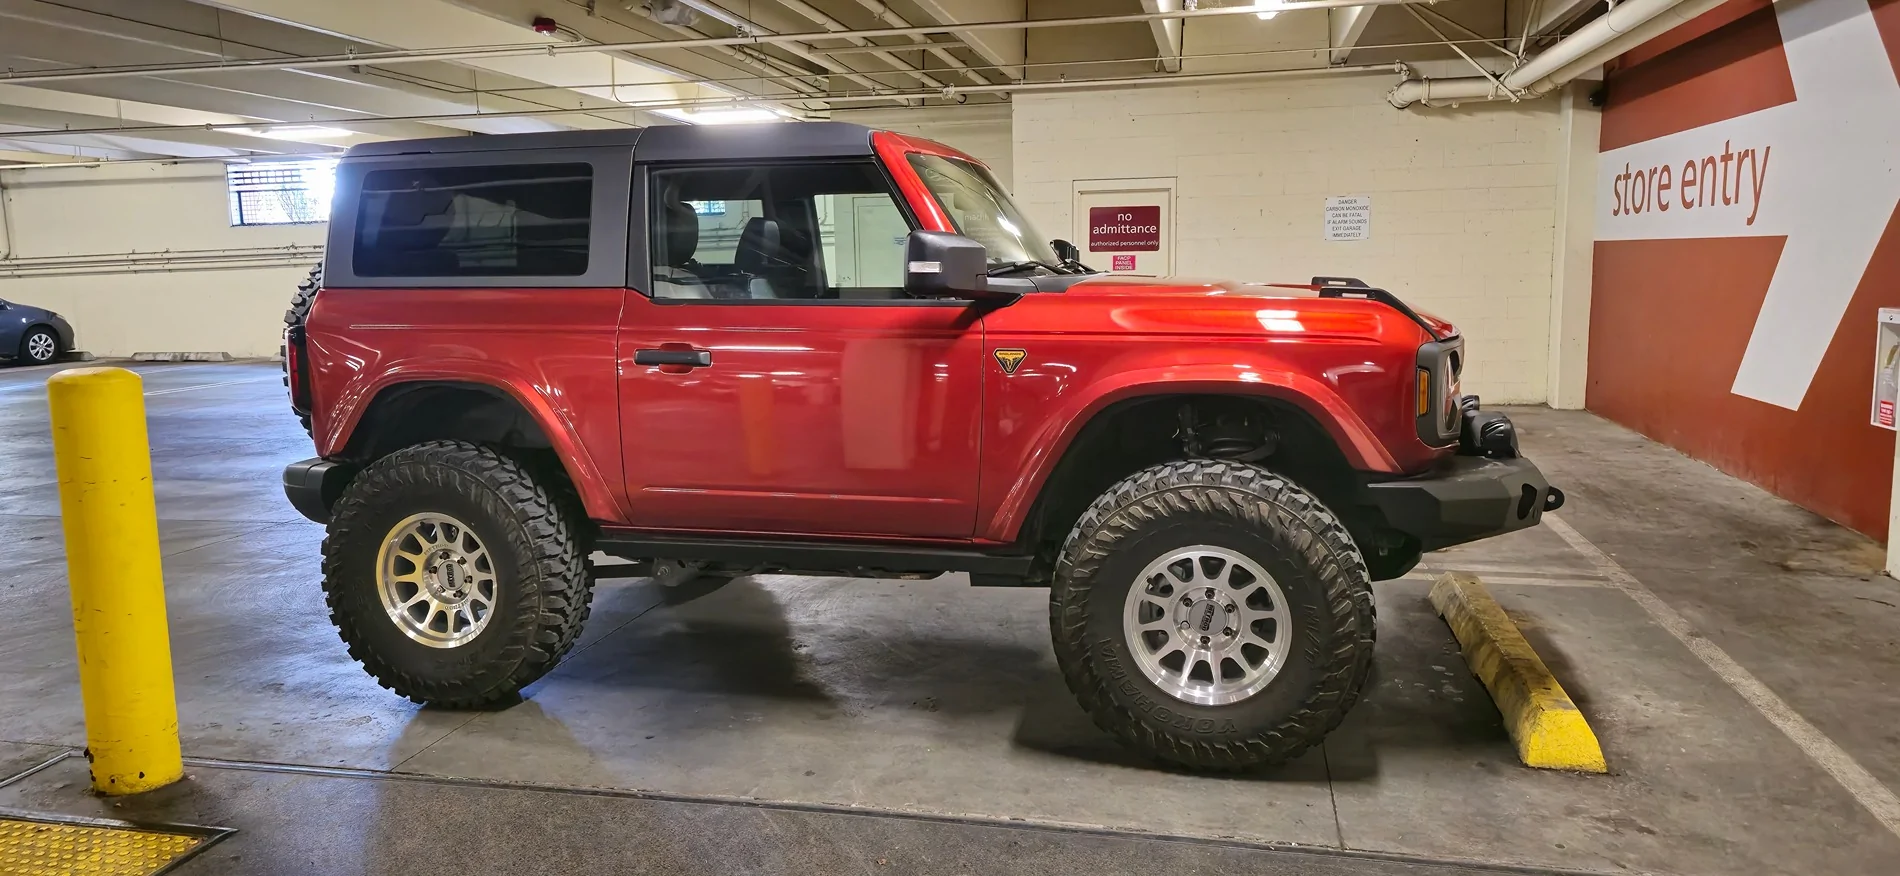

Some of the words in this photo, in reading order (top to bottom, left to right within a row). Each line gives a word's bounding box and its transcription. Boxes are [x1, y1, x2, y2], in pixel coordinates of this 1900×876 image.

[1613, 162, 1671, 216] store
[1681, 139, 1771, 226] entry
[1092, 224, 1157, 234] admittance
[1118, 213, 1132, 222] no
[1098, 637, 1238, 734] YOKOHAMA
